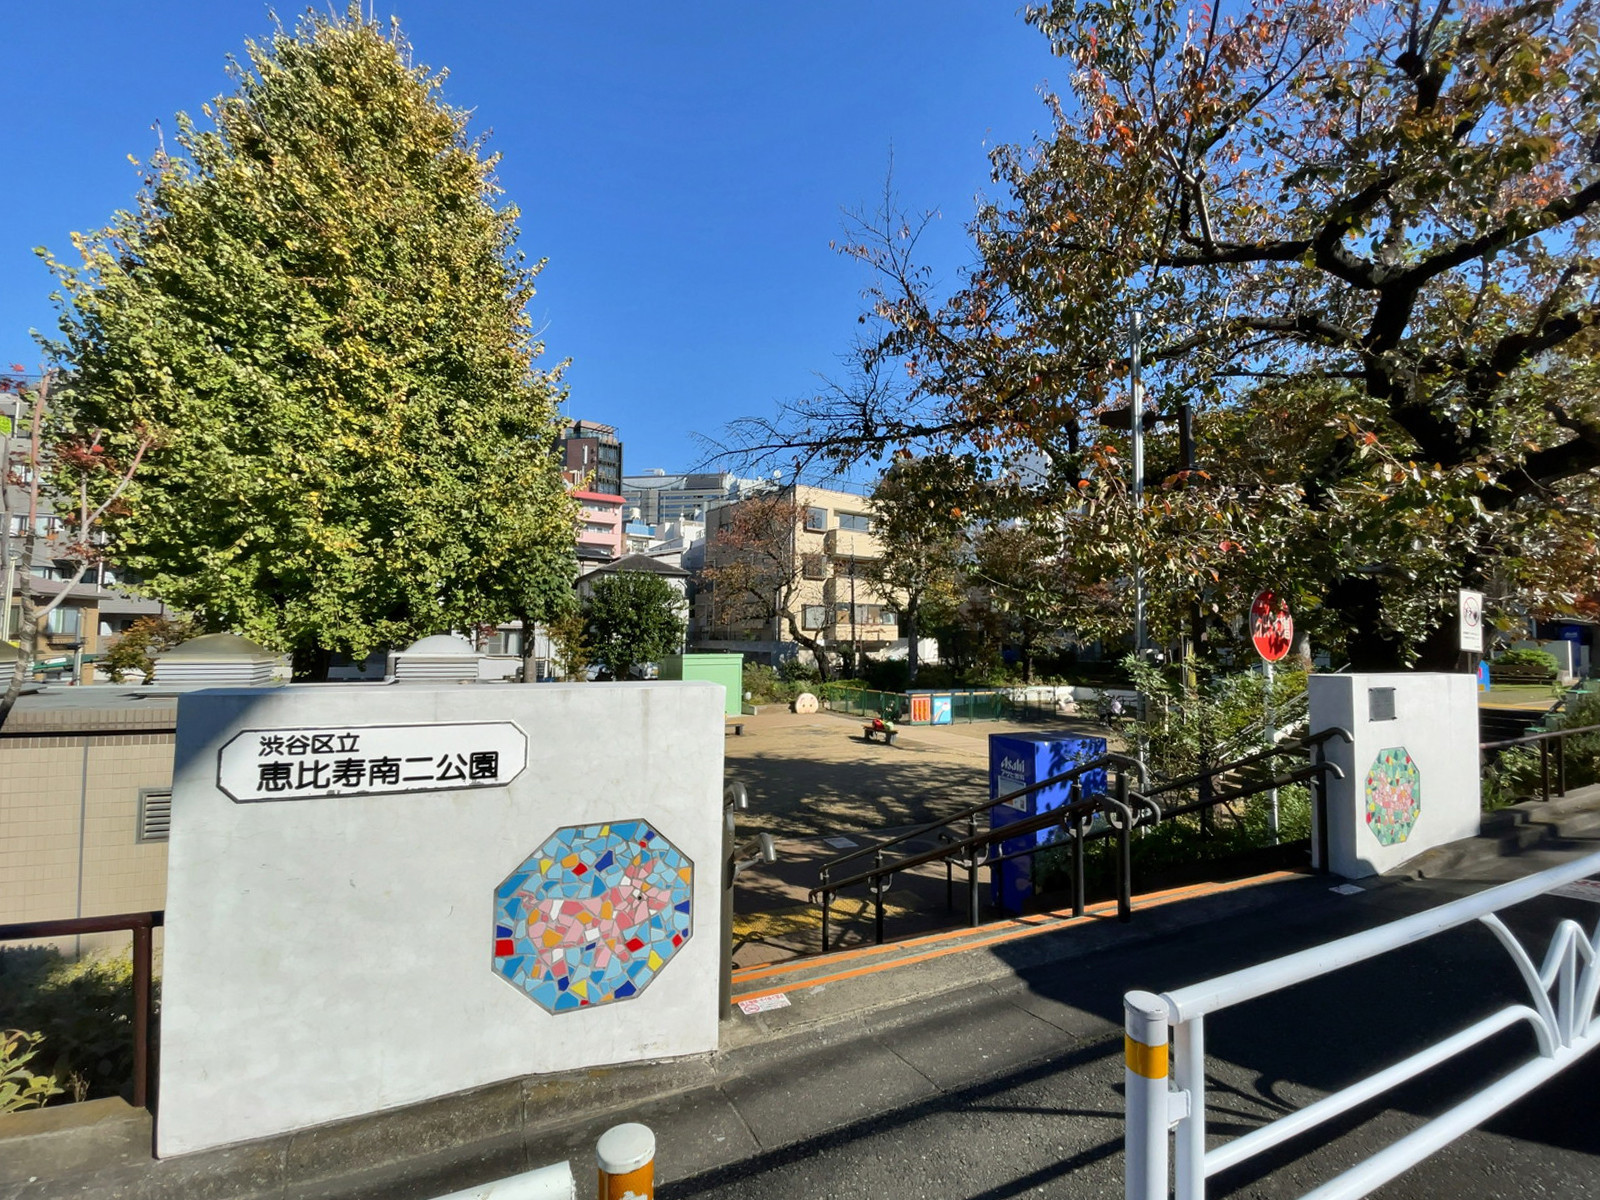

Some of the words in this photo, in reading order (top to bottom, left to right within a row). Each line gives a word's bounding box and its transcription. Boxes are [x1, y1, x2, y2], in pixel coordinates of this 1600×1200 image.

[258, 732, 360, 756] 渋谷区立
[256, 751, 499, 792] 恵比寿南二公園
[1001, 755, 1025, 773] Asahi
